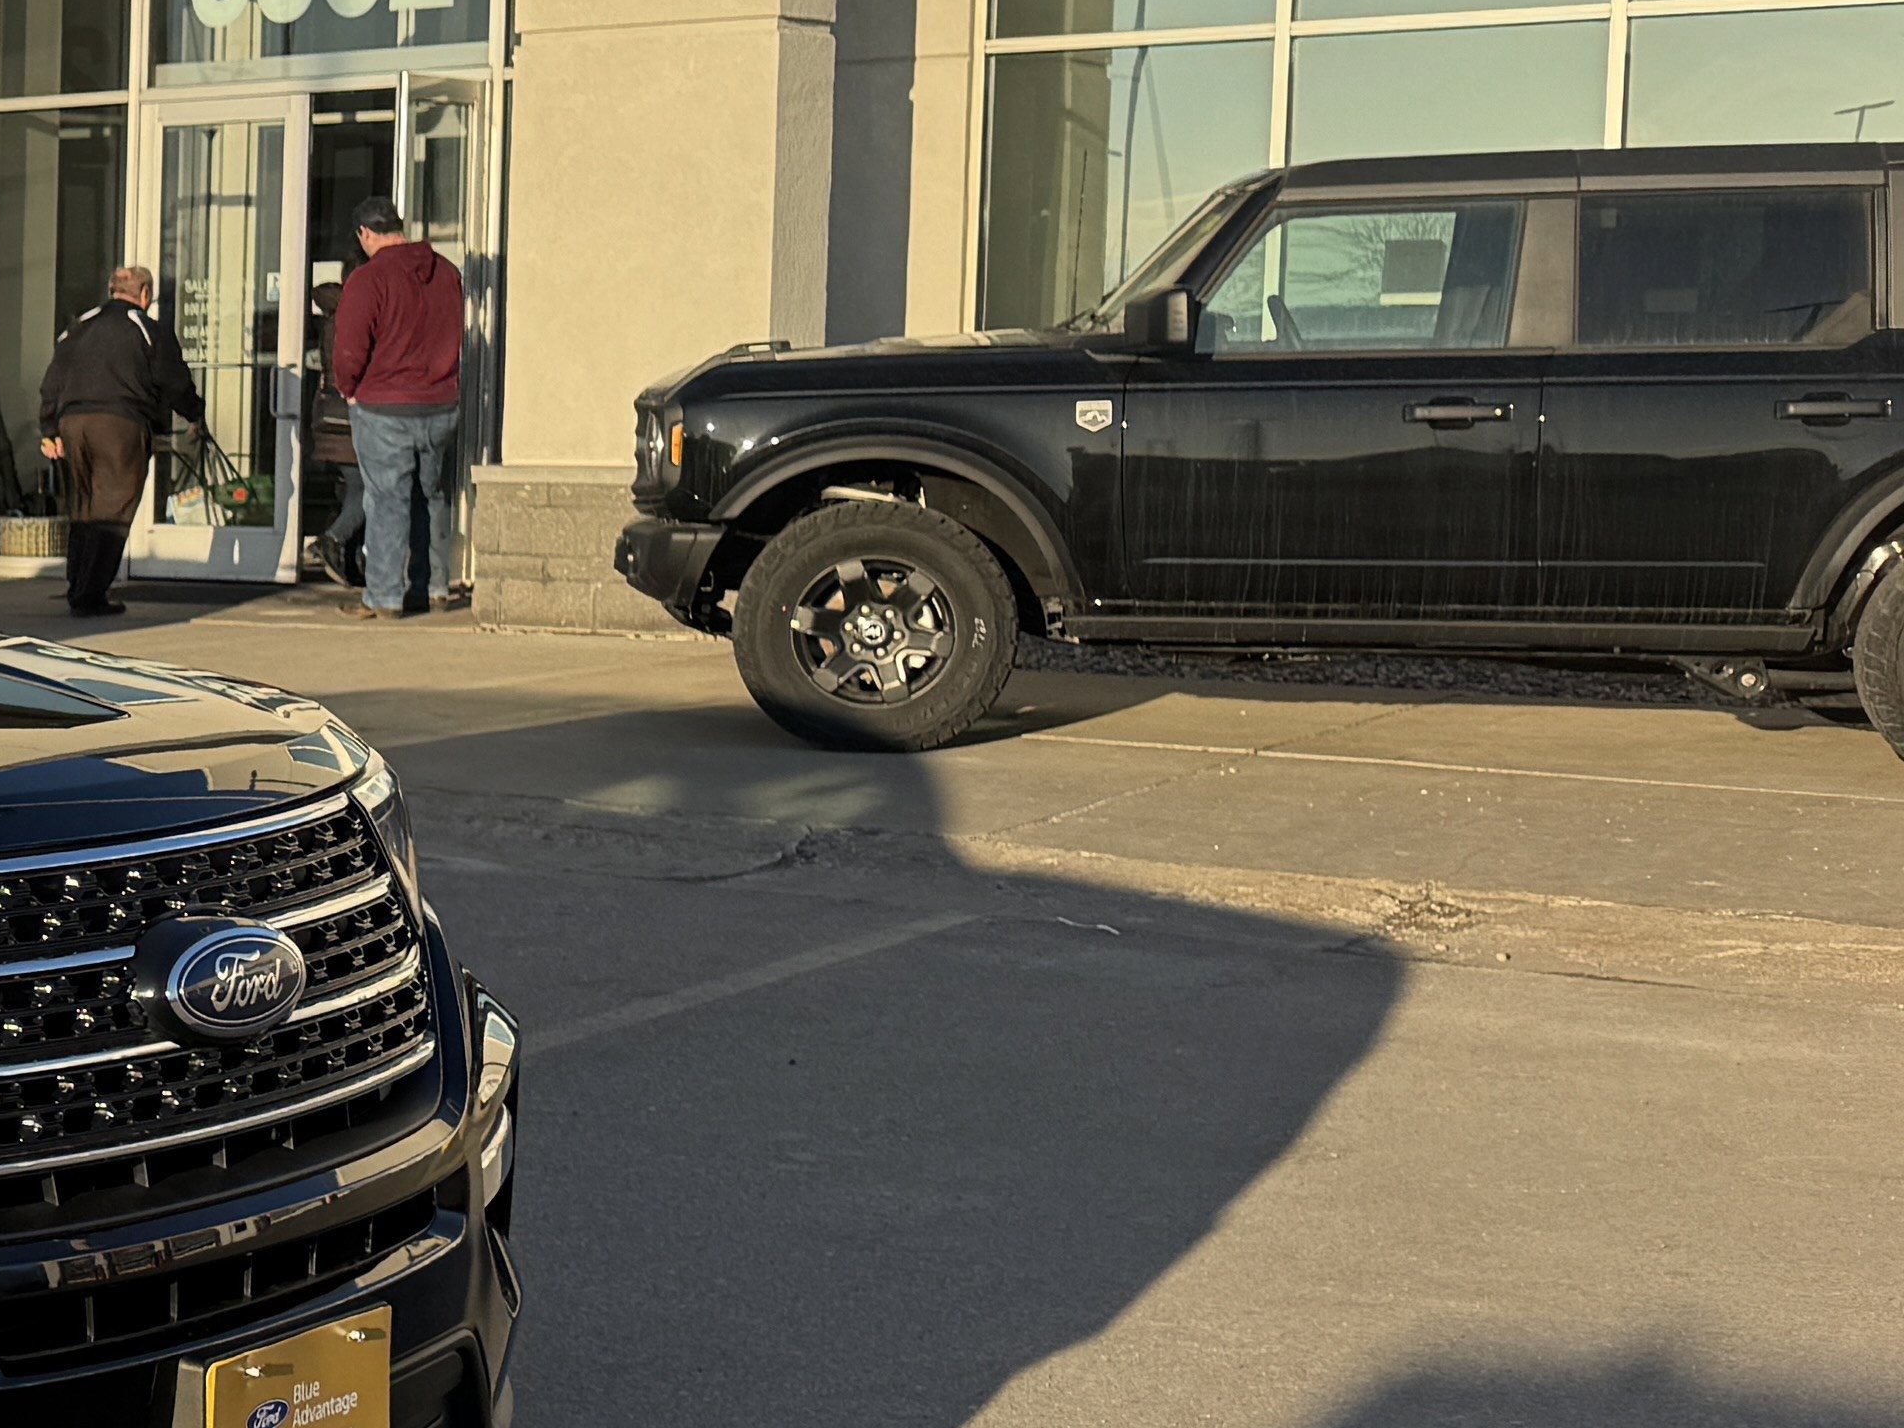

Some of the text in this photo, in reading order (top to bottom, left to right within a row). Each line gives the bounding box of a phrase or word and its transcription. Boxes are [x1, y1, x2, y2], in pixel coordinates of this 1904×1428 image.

[210, 949, 283, 1013] Ford
[292, 1391, 358, 1428] Advantage
[293, 1380, 321, 1405] Blue
